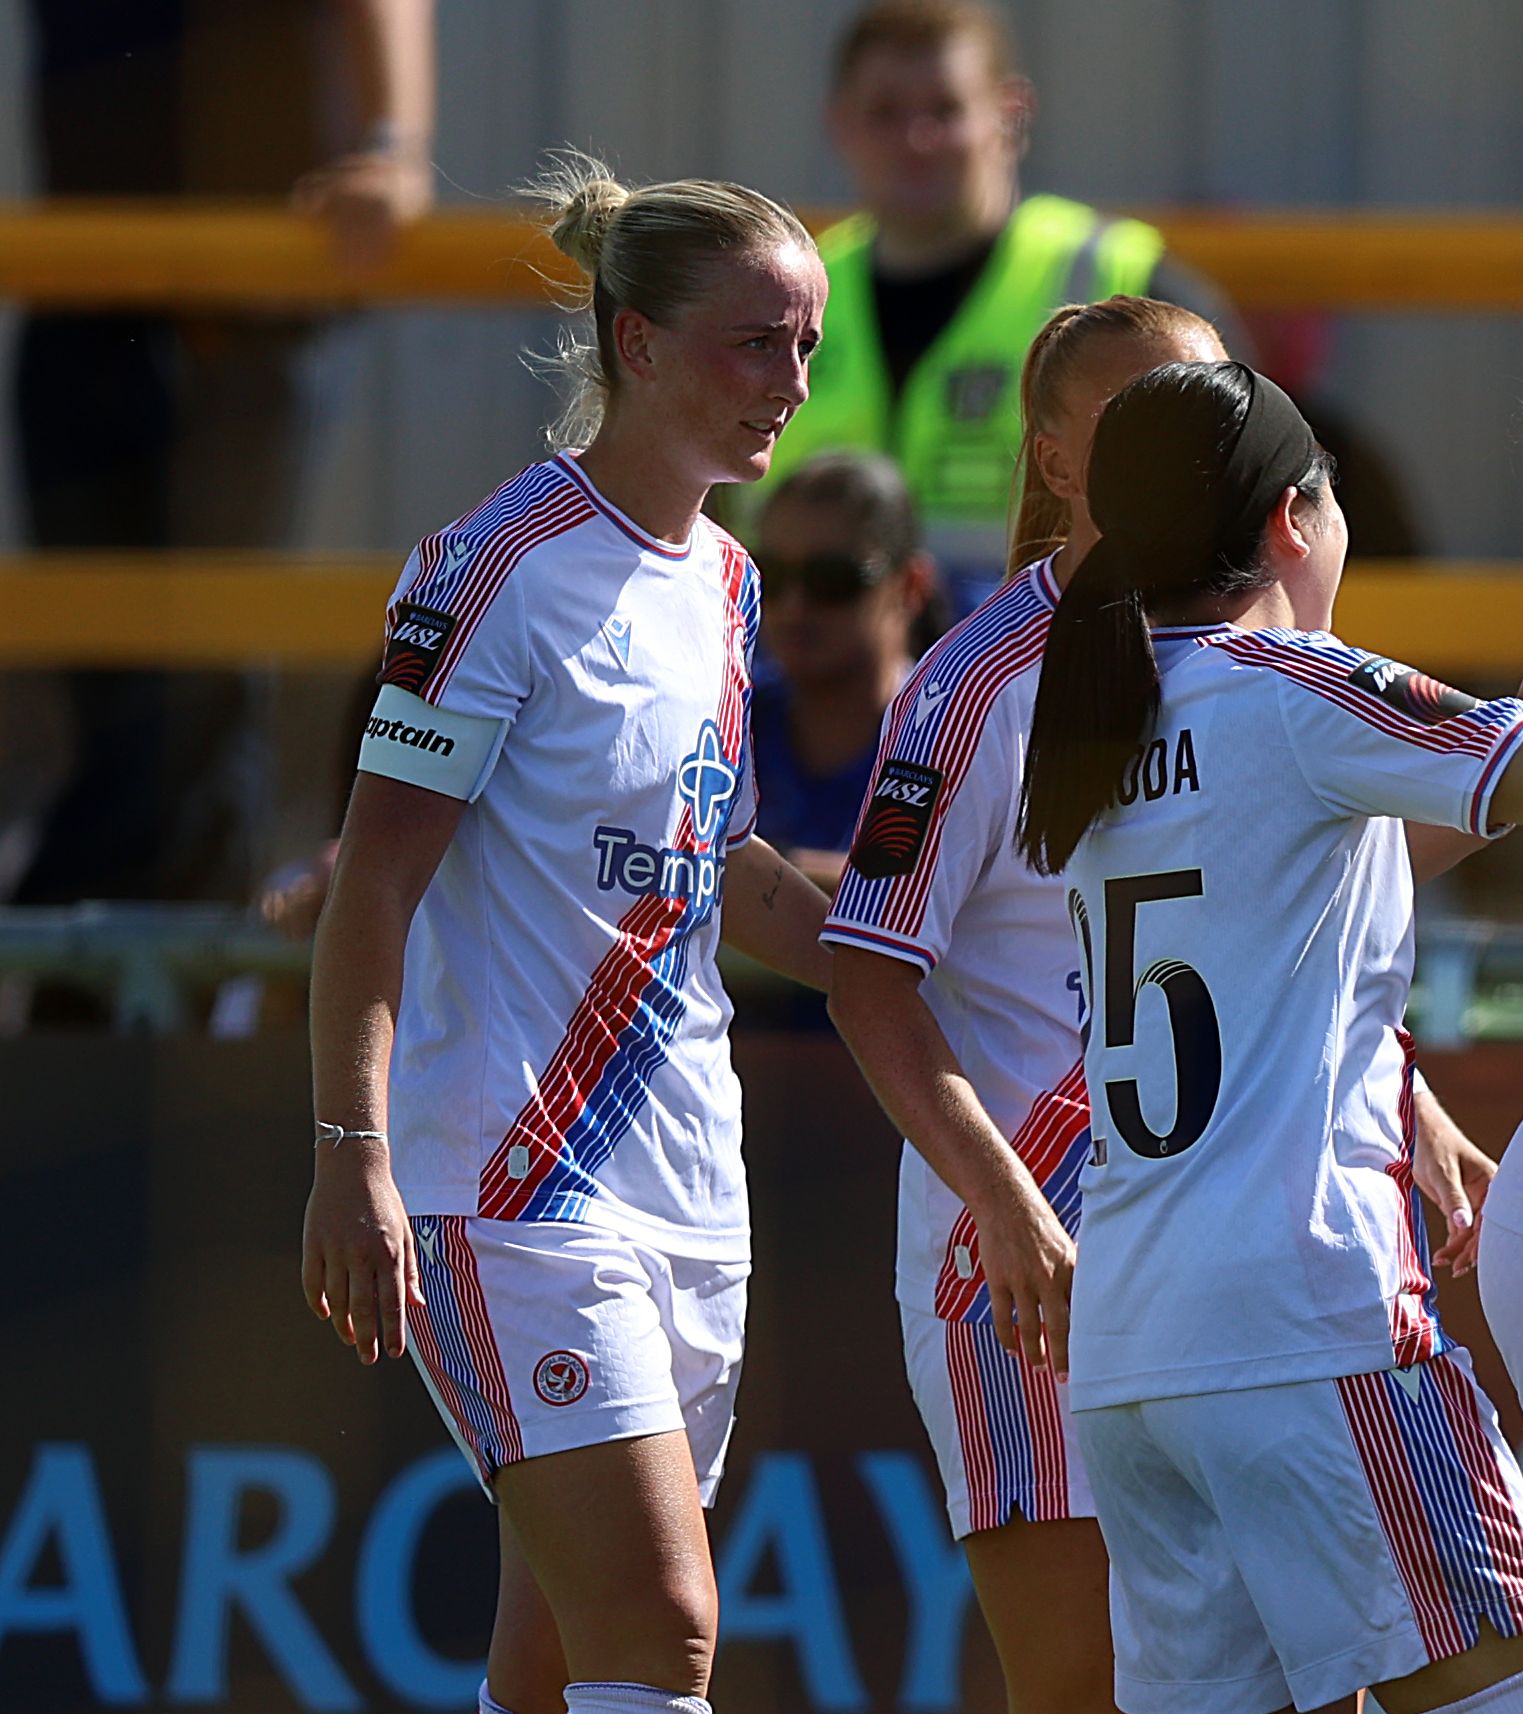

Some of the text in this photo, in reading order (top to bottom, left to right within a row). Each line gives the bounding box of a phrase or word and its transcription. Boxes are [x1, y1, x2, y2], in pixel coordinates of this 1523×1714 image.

[393, 622, 443, 651] WSL
[366, 716, 456, 757] aptain
[875, 778, 930, 807] WSL
